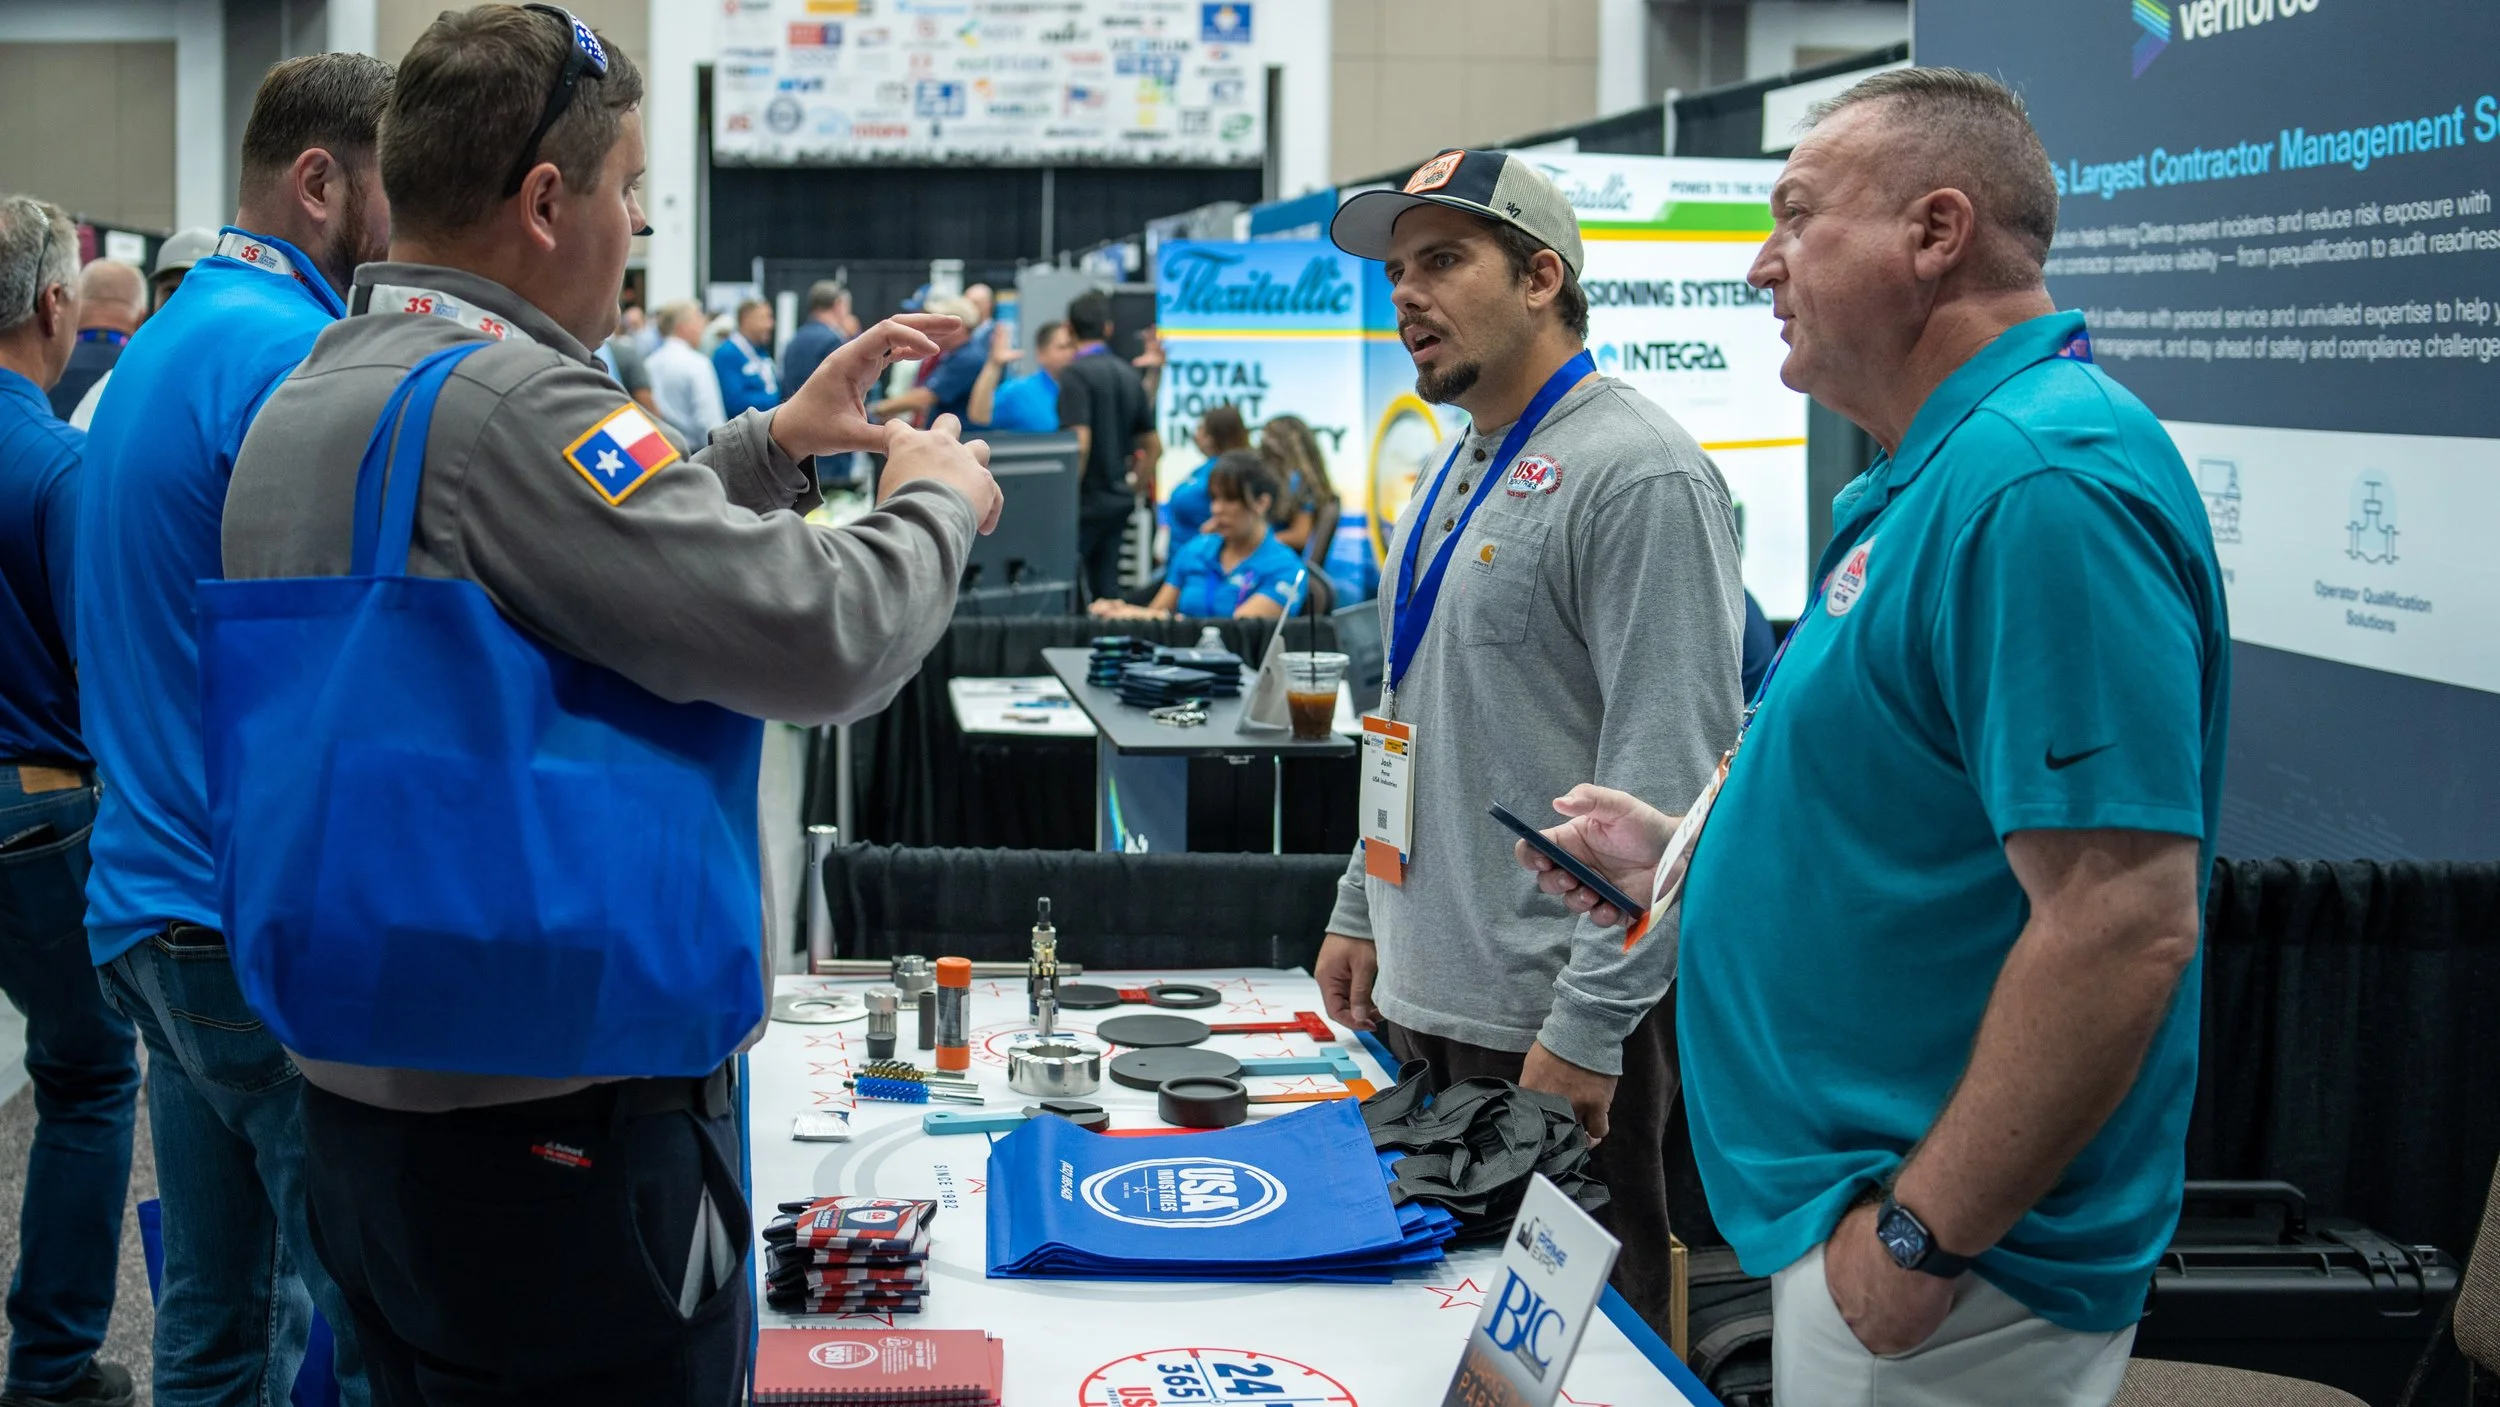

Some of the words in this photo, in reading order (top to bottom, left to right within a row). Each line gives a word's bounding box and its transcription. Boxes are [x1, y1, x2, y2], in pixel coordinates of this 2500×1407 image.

[2070, 157, 2147, 200] Largest
[2151, 139, 2274, 187] Contractor
[2280, 104, 2466, 171] Management
[2138, 221, 2176, 245] Clients
[2176, 219, 2219, 245] prevent
[2220, 213, 2275, 237] incidents
[2277, 209, 2303, 234] and
[2305, 206, 2352, 231] reduce
[2355, 200, 2382, 226] risk
[2383, 197, 2454, 227] exposure
[2457, 189, 2491, 216] with
[2113, 251, 2174, 276] compliance
[2176, 247, 2218, 274] visibility
[2237, 244, 2267, 267] from
[2269, 237, 2368, 269] prequalification
[2371, 237, 2386, 259] to
[2388, 231, 2427, 256] audit
[404, 297, 433, 314] 3S
[2173, 304, 2223, 332] personal
[2224, 305, 2269, 328] service
[2270, 303, 2296, 328] and
[2298, 302, 2362, 327] unrivalled
[2364, 299, 2432, 329] expertise
[2435, 300, 2452, 322] to
[2455, 296, 2491, 326] help
[1623, 342, 1728, 370] INTEGRA
[2189, 338, 2213, 363] stay
[2214, 336, 2252, 358] ahead
[2254, 335, 2268, 358] of
[2269, 335, 2307, 364] safety
[2310, 334, 2337, 358] and
[2339, 334, 2421, 363] compliance
[1170, 361, 1269, 388] TOTAL
[1513, 460, 1548, 485] USA
[2314, 579, 2361, 602] Operator
[2363, 586, 2433, 614] Qualification
[2346, 608, 2396, 634] Solutions
[933, 1164, 953, 1186] SINCE
[1157, 1168, 1179, 1213] INDUSTRIES
[1178, 1167, 1240, 1213] USA
[941, 1189, 959, 1209] 1982
[1482, 1265, 1566, 1369] BIC
[1157, 1363, 1206, 1398] 365
[1212, 1363, 1286, 1396] 24
